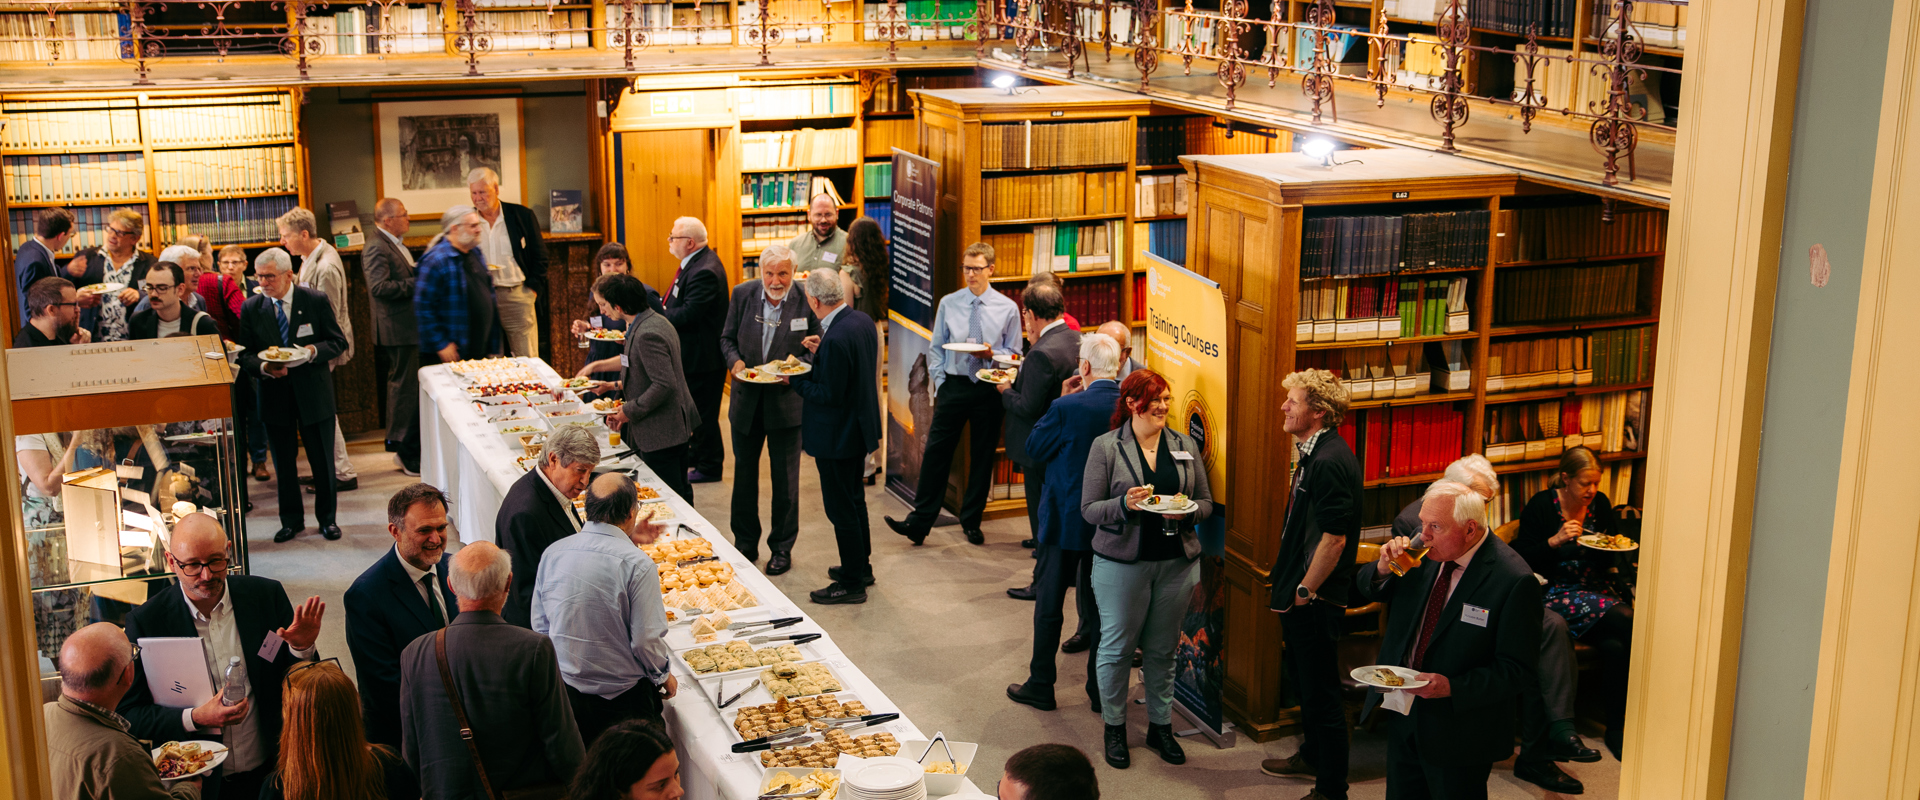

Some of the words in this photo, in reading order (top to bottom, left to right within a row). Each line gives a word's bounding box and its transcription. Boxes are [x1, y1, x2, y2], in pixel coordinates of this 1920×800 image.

[893, 190, 916, 211] Corporate
[916, 199, 933, 218] Patrons
[1150, 307, 1179, 344] Training
[1181, 325, 1219, 358] Courses
[830, 590, 847, 598] HOKA
[171, 681, 187, 694] hp
